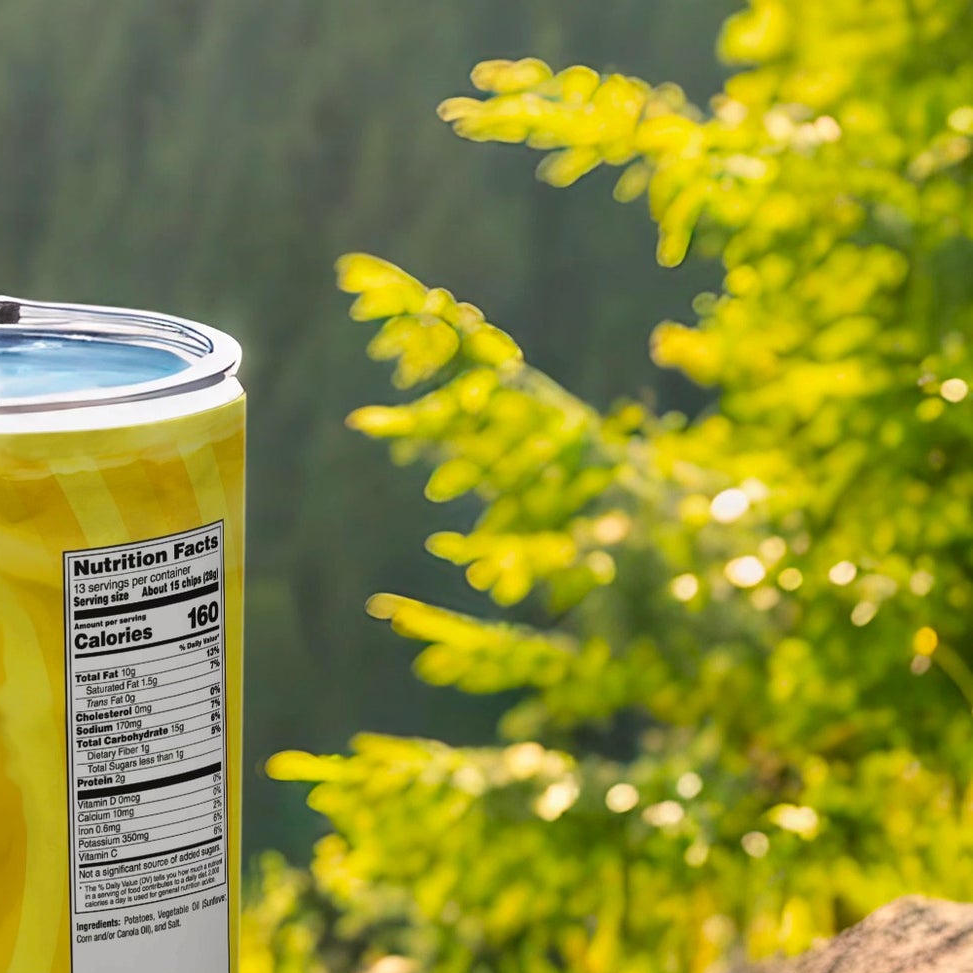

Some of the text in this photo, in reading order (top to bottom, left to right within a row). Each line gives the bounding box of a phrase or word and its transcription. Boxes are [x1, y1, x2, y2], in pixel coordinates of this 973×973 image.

[74, 536, 218, 576] Nutrition Facts
[73, 568, 219, 607] Serving size About 15 chips (28g)
[74, 566, 191, 594] 13 servings per container
[74, 614, 147, 630] Amount per serving
[74, 601, 219, 650] Calories 160
[187, 640, 202, 649] Daily
[75, 645, 220, 683] Total Fat 10g 13%
[86, 658, 220, 695] Saturated Fat 1.5g 7%
[76, 684, 220, 722] Cholesterol 0mg 0%
[87, 694, 136, 708] Trans Fat 0g
[76, 698, 220, 736] Sodium 170mg 7%
[76, 738, 102, 748] Total
[104, 727, 168, 745] Carbohydrate
[171, 723, 184, 733] 15g
[87, 724, 221, 760] Dietary Fiber 1g 5%
[88, 750, 184, 773] Total Sugars less than 1g
[77, 774, 126, 788] Protein 2g
[78, 798, 107, 809] Vitamin
[110, 796, 116, 806] D
[118, 794, 141, 804] 0mcg
[78, 808, 134, 822] Calcium 10mg
[78, 824, 121, 835] Iron 0.6mg
[78, 832, 149, 848] Potassium 350mg
[79, 848, 118, 862] Vitamin C
[79, 844, 220, 879] Not a significant source of added sugars
[97, 890, 119, 899] serving
[127, 886, 140, 894] food
[105, 881, 120, 890] Daily
[121, 879, 138, 887] Value
[139, 875, 153, 886] (DV)
[153, 874, 165, 882] tells
[166, 872, 176, 880] you
[85, 886, 179, 908] calories used general
[76, 901, 200, 932] Ingredients: Potatoes, Vegetable Oil
[76, 919, 182, 944] Corn and/or Canola and Salt.
